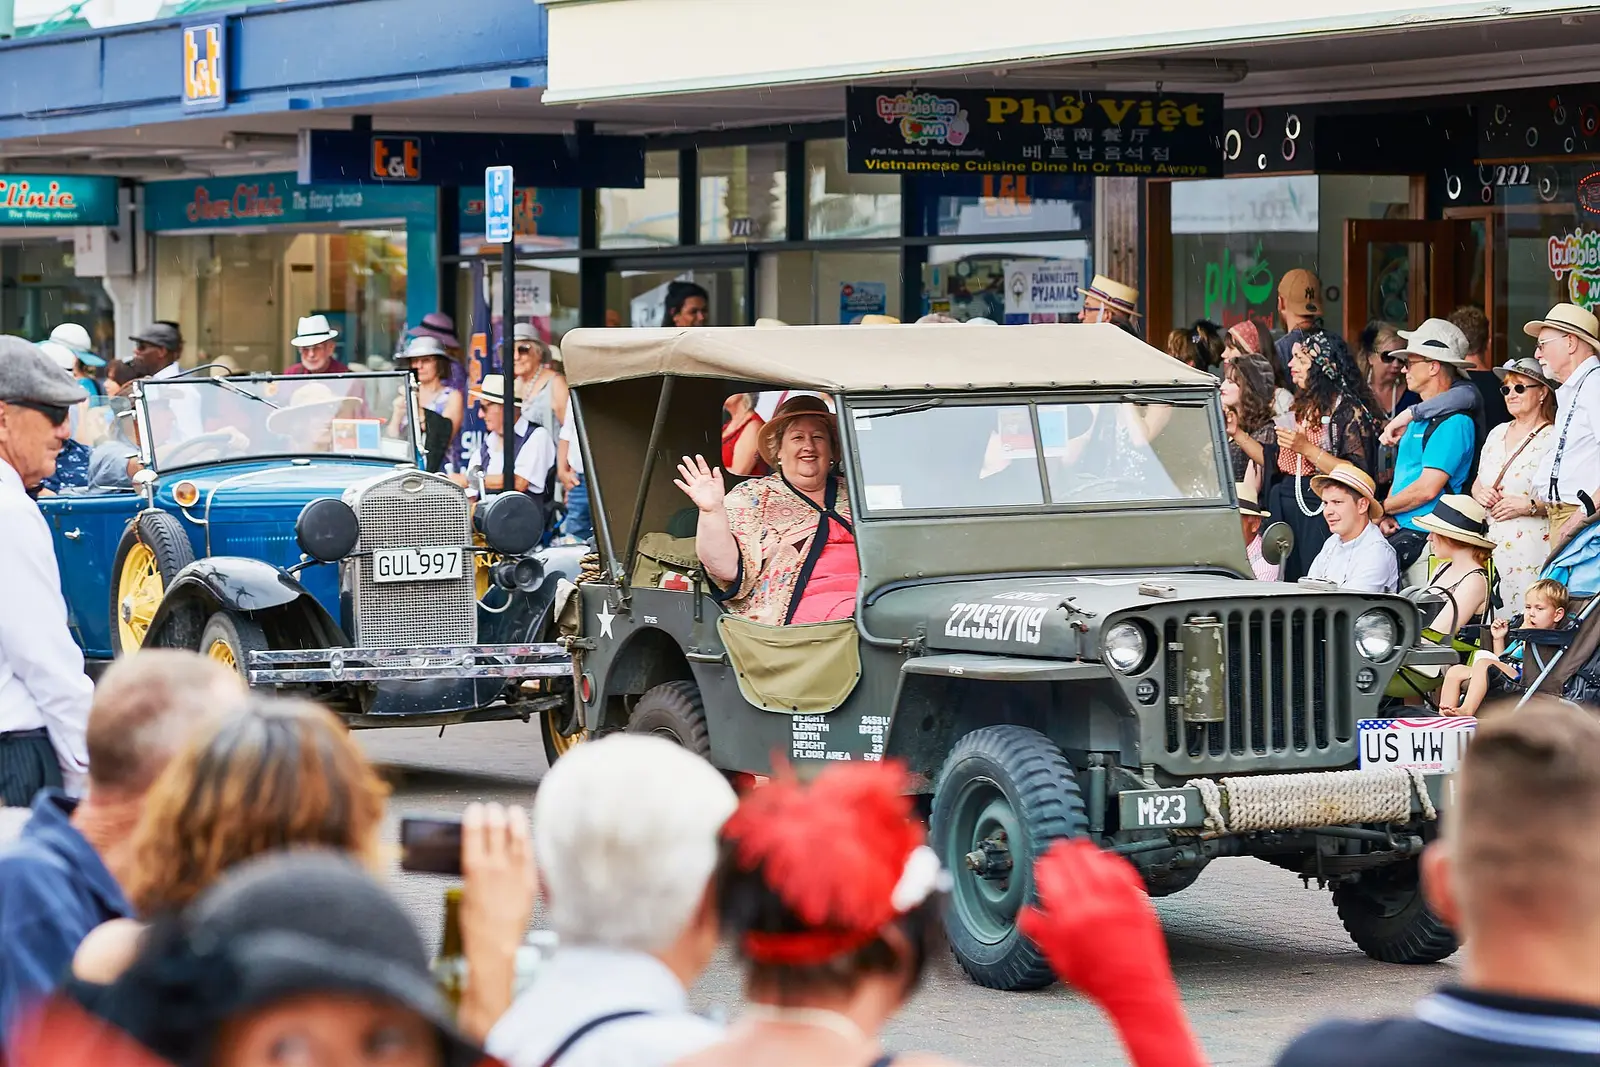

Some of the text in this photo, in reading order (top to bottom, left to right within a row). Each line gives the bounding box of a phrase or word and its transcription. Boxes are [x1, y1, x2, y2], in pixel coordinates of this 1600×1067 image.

[986, 95, 1205, 132] Phở Việt
[374, 139, 419, 177] t&t
[865, 159, 1208, 174] Vietnamese Cuisine Dine In Or Take Aways
[1496, 166, 1530, 186] 222
[1031, 272, 1079, 284] FLANNELETTE
[1031, 286, 1079, 302] PYJAMAS
[379, 552, 458, 577] GUL997
[792, 722, 830, 732] LENGTH
[792, 731, 820, 741] WIDTH
[792, 740, 827, 750] HEIGHT
[1366, 733, 1399, 763] US
[1411, 731, 1444, 762] WW
[793, 749, 825, 759] FLOOR
[825, 751, 852, 761] AREA
